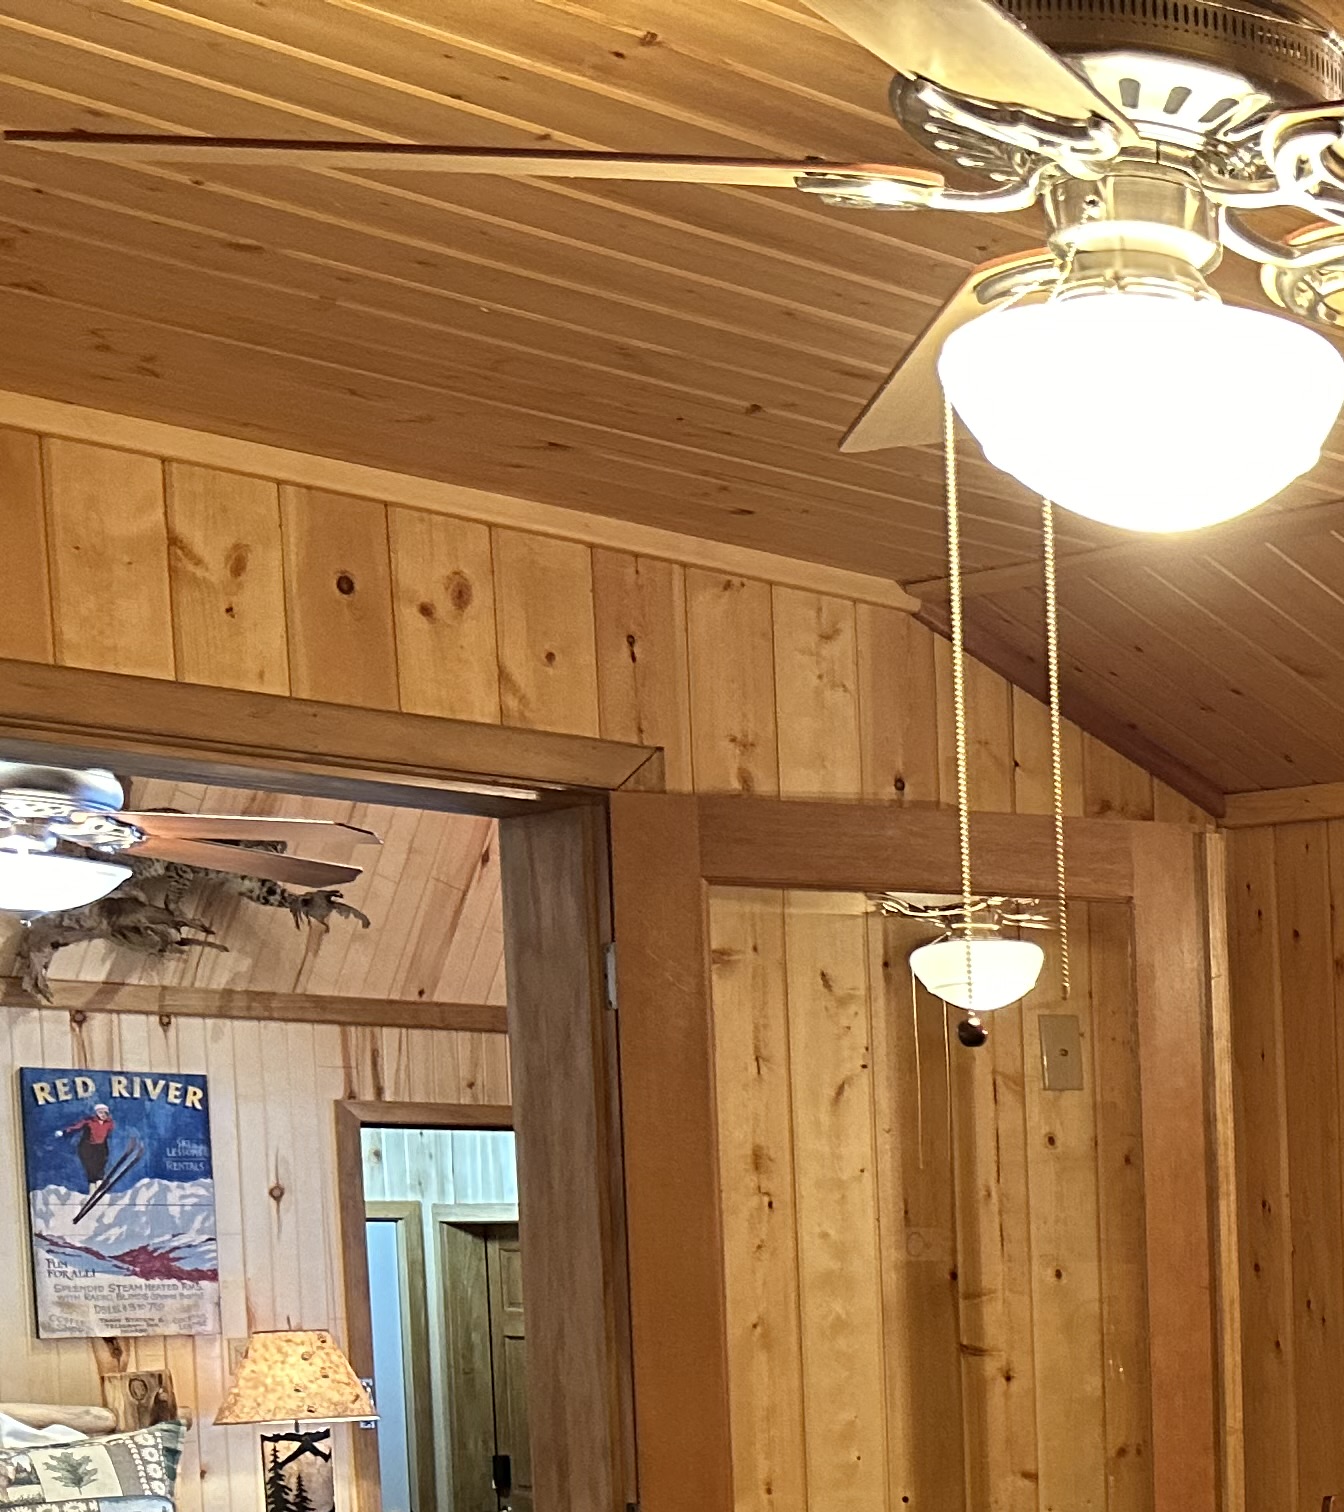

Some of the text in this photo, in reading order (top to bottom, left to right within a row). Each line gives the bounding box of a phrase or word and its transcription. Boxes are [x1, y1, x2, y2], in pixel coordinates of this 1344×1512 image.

[32, 1075, 203, 1110] RED RIVER
[47, 1269, 73, 1281] FOR
[108, 1283, 143, 1293] STEAM
